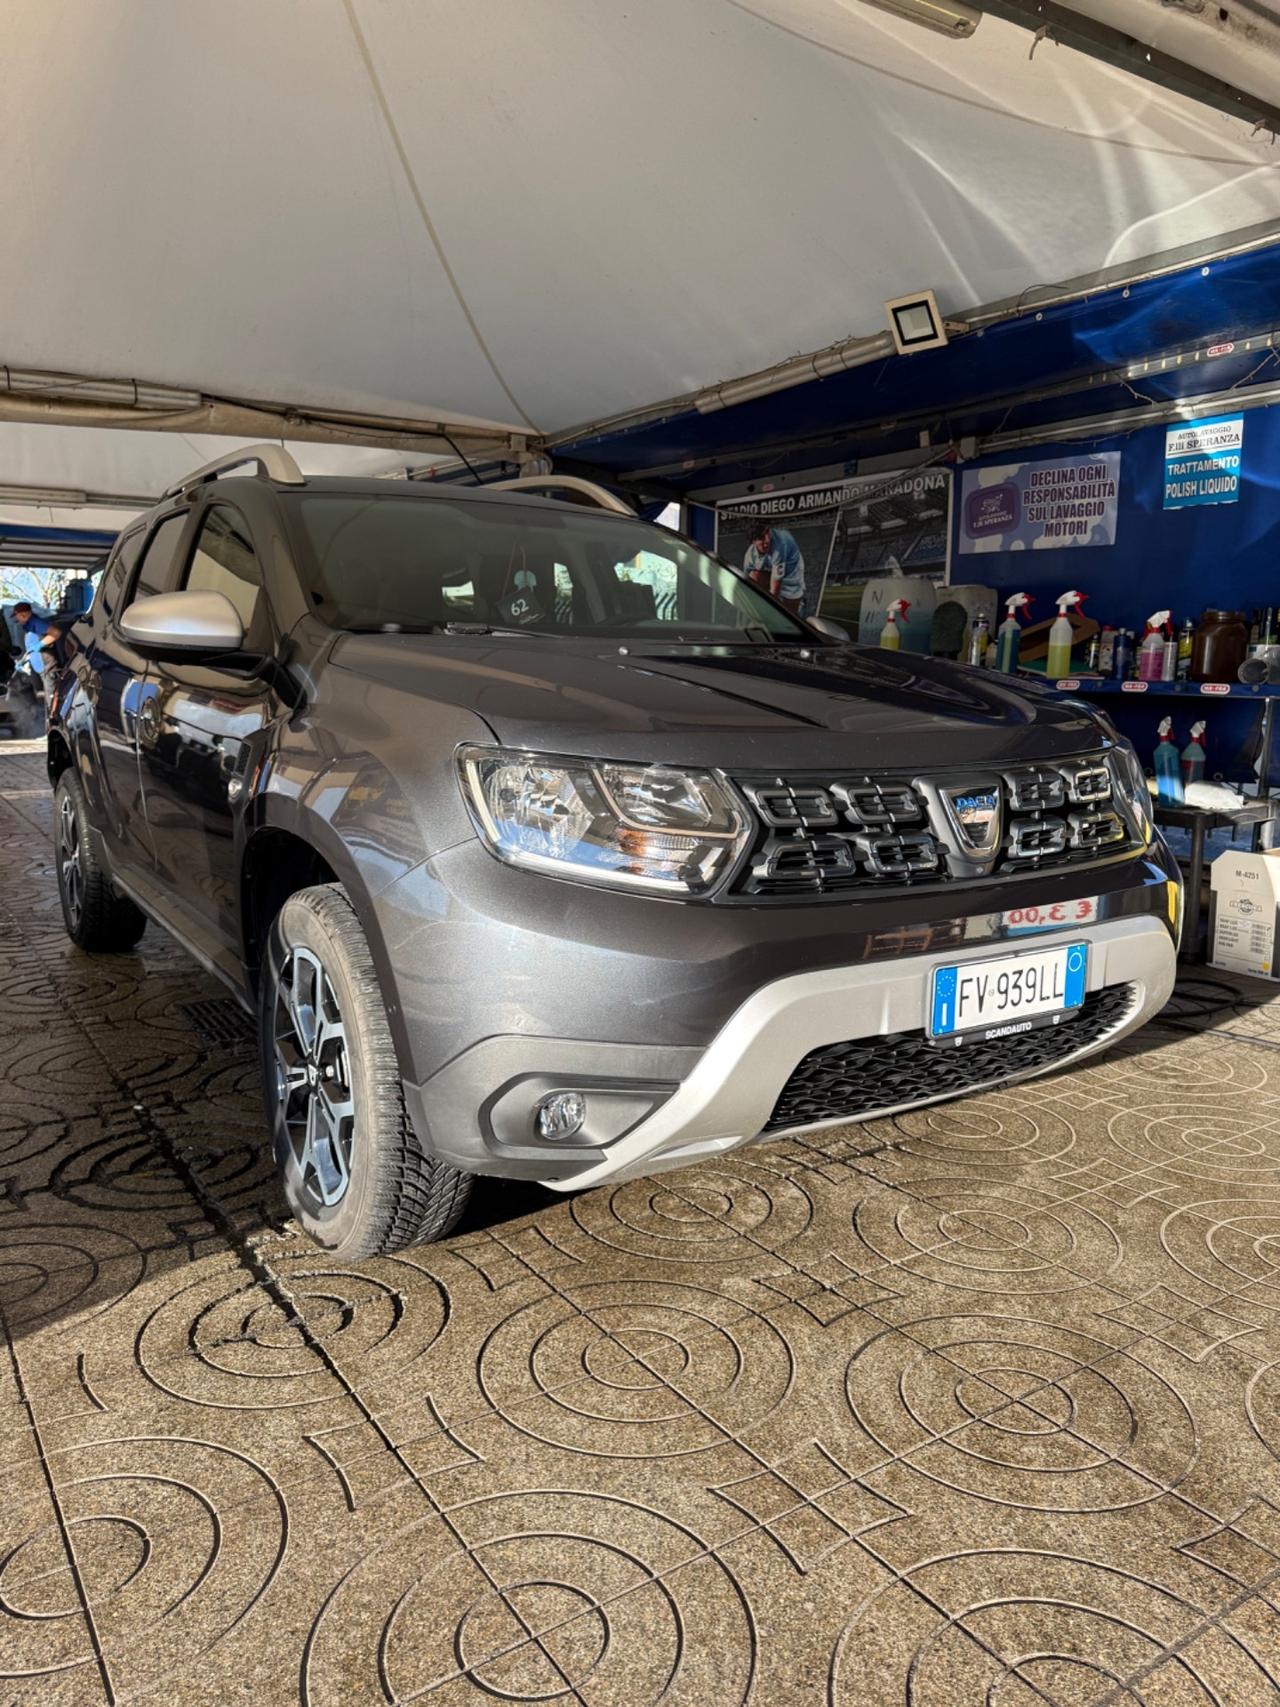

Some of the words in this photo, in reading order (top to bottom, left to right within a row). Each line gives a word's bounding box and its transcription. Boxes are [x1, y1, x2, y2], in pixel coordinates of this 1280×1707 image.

[1186, 433, 1241, 451] SPERANZA
[1167, 455, 1240, 476] TRATTAMENTO
[1031, 469, 1075, 487] DECLINA
[1078, 465, 1106, 482] OGNI
[1023, 479, 1115, 505] RESPONSABILITÀ
[1165, 480, 1197, 499] POLISH
[1199, 475, 1238, 496] LIQUIDO
[760, 497, 796, 514] DIEGO
[797, 486, 859, 510] ARMANDO
[1028, 507, 1047, 521] SUL
[1050, 501, 1105, 520] LAVAGGIO
[1044, 520, 1088, 538] MOTORI
[511, 598, 529, 616] 62
[985, 1022, 1032, 1040] SCANDAUTO
